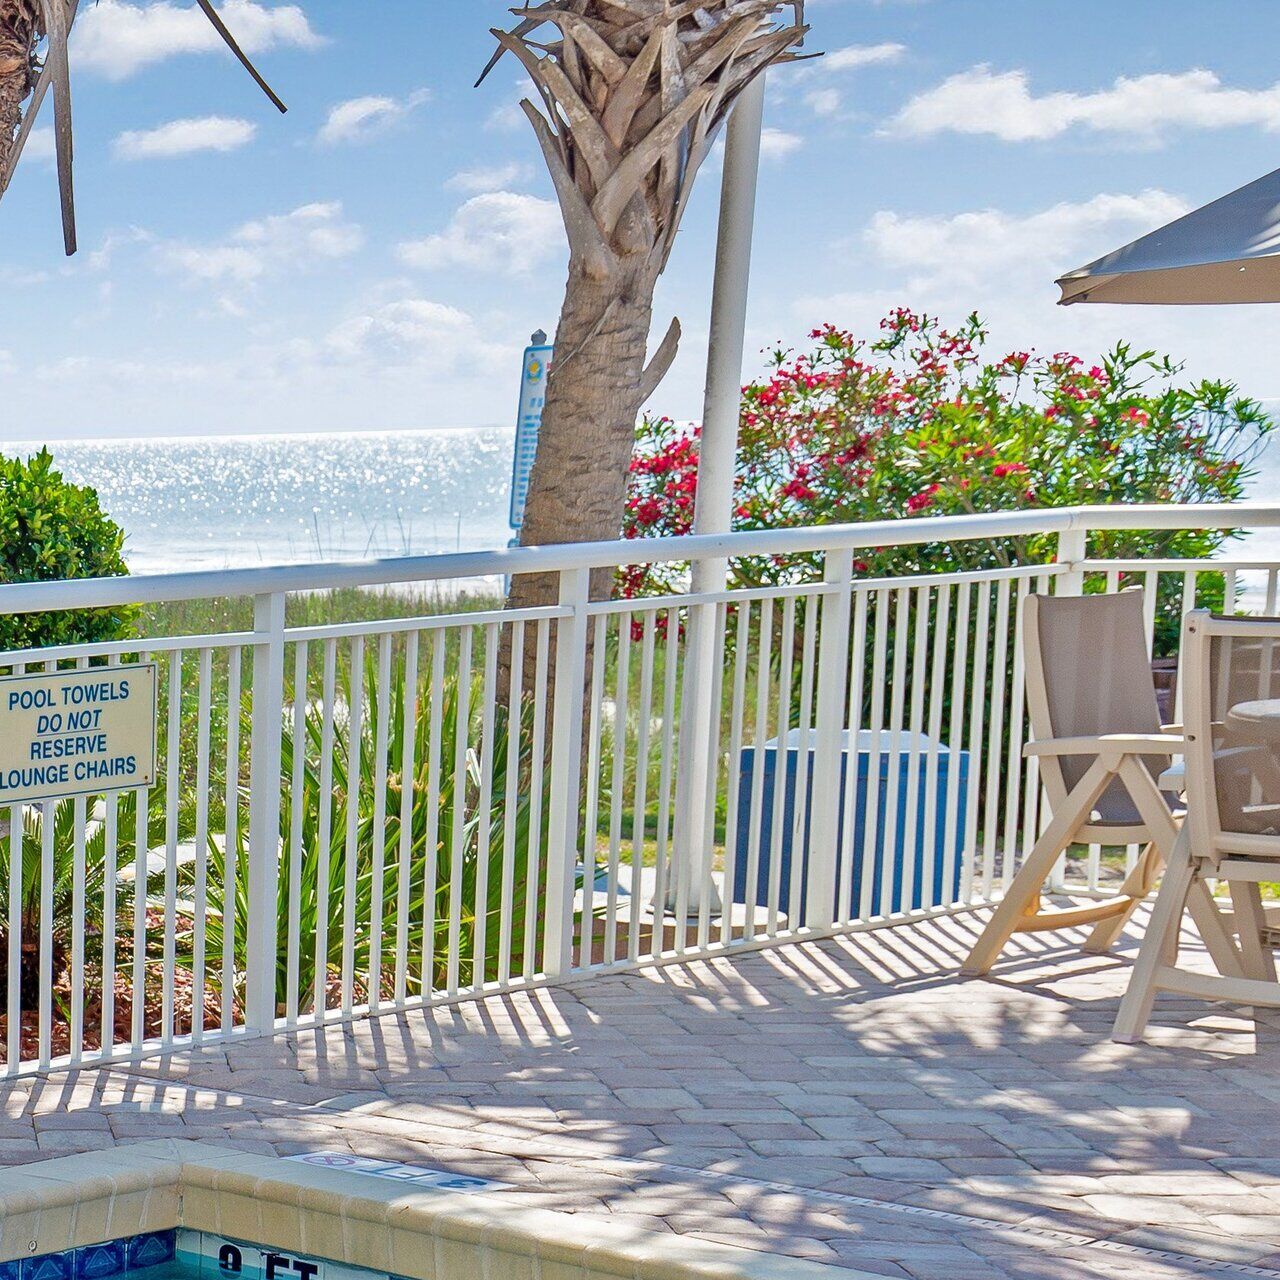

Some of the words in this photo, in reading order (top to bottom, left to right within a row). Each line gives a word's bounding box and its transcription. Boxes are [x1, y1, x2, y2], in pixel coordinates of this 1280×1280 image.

[8, 689, 56, 710] POOL
[61, 681, 129, 704] TOWELS
[37, 713, 62, 734] DO
[68, 709, 102, 730] NOT
[30, 734, 107, 760] RESERVE
[0, 764, 68, 790] LOUNGE
[74, 756, 136, 780] CHAIRS
